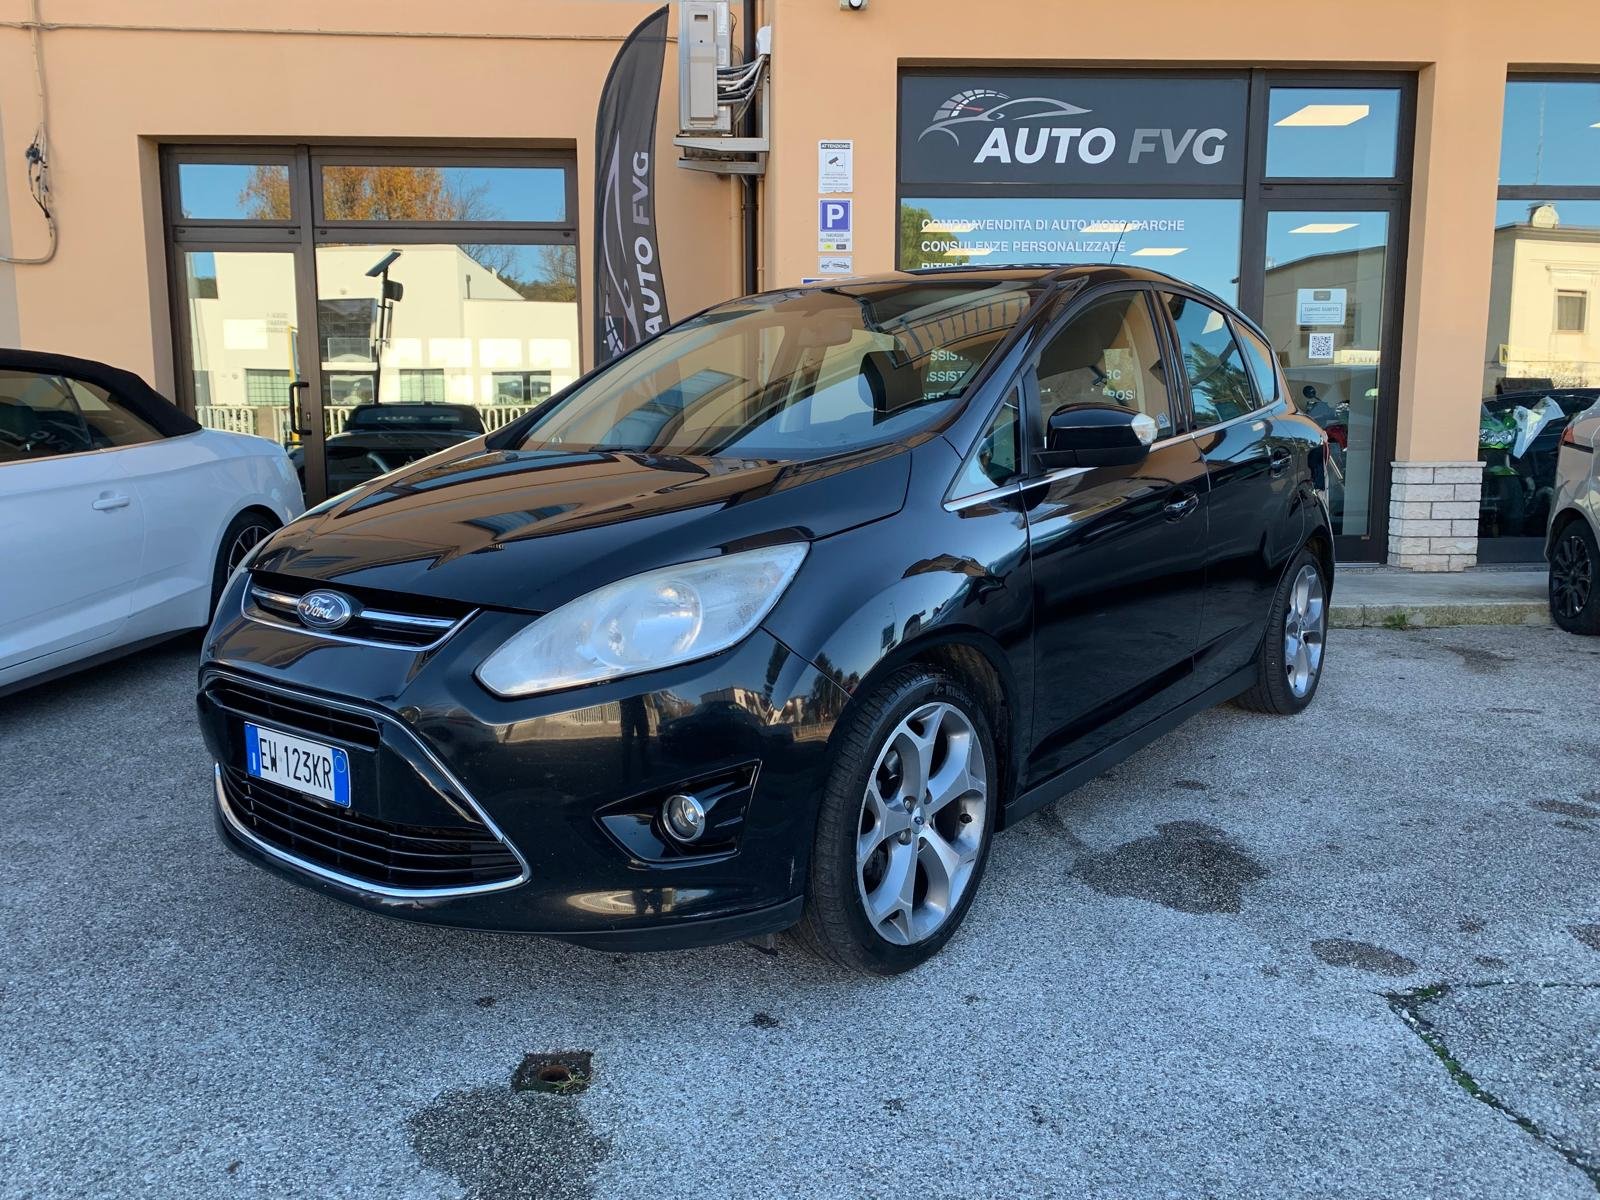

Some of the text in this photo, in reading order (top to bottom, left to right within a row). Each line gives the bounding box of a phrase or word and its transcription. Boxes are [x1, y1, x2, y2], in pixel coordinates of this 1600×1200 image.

[973, 127, 1228, 164] AUTO FVG
[826, 204, 845, 228] P
[1035, 219, 1047, 231] DI
[1054, 219, 1087, 231] AUTO
[632, 151, 663, 335] AUTO FVG
[921, 240, 1126, 252] CONSULENZE PERSONALIZZATE
[304, 596, 336, 619] Ford
[259, 737, 333, 791] EW 123KR
